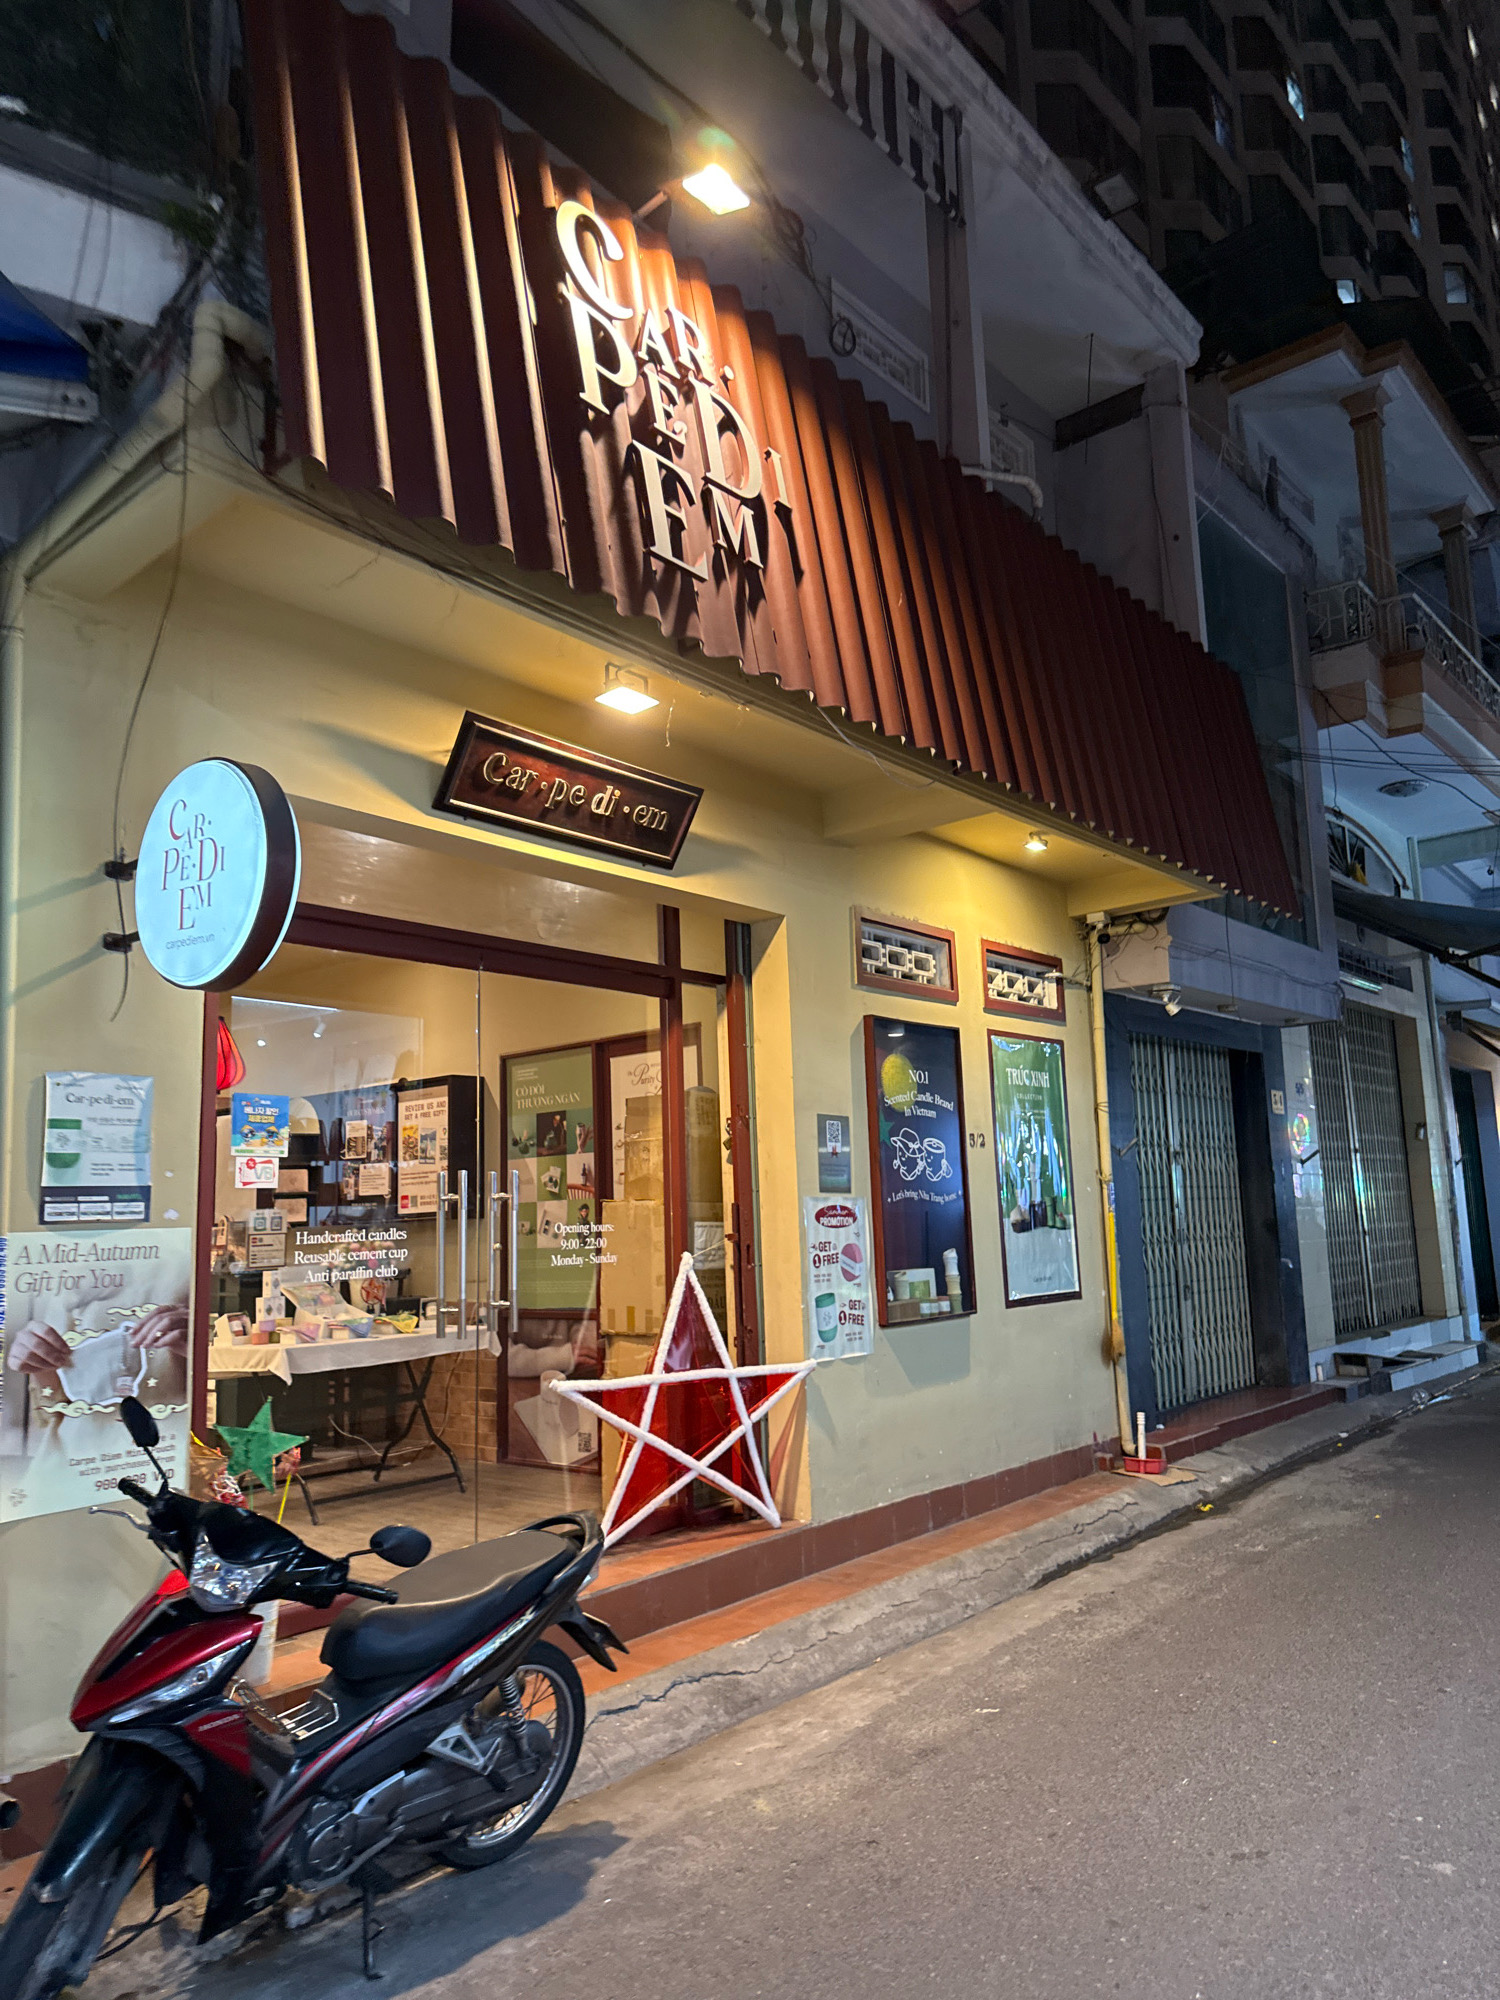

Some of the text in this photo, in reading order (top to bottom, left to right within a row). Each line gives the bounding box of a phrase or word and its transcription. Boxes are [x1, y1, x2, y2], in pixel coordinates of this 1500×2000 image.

[908, 1070, 929, 1084] NO.1
[1006, 1065, 1050, 1088] TRÚC XINH
[884, 1090, 954, 1111] Scented Candle Brand
[904, 1105, 937, 1119] In Vietnam
[820, 1216, 854, 1226] PROMOTION
[554, 1222, 590, 1236] Opening
[296, 1228, 407, 1245] Handcrafted candles
[560, 1239, 579, 1250] 9:00
[584, 1238, 607, 1249] 22:00
[818, 1241, 832, 1252] GET
[13, 1243, 159, 1265] A Mid-Autumn
[294, 1249, 346, 1264] Reusable
[347, 1250, 387, 1261] cement
[388, 1248, 408, 1261] cup
[551, 1254, 585, 1267] Monday
[589, 1252, 619, 1266] Sunday
[822, 1252, 839, 1266] FREE
[304, 1264, 398, 1283] Anti paraffin club
[15, 1268, 124, 1297] Gift for You
[848, 1299, 861, 1310] GET
[848, 1313, 864, 1326] FREE
